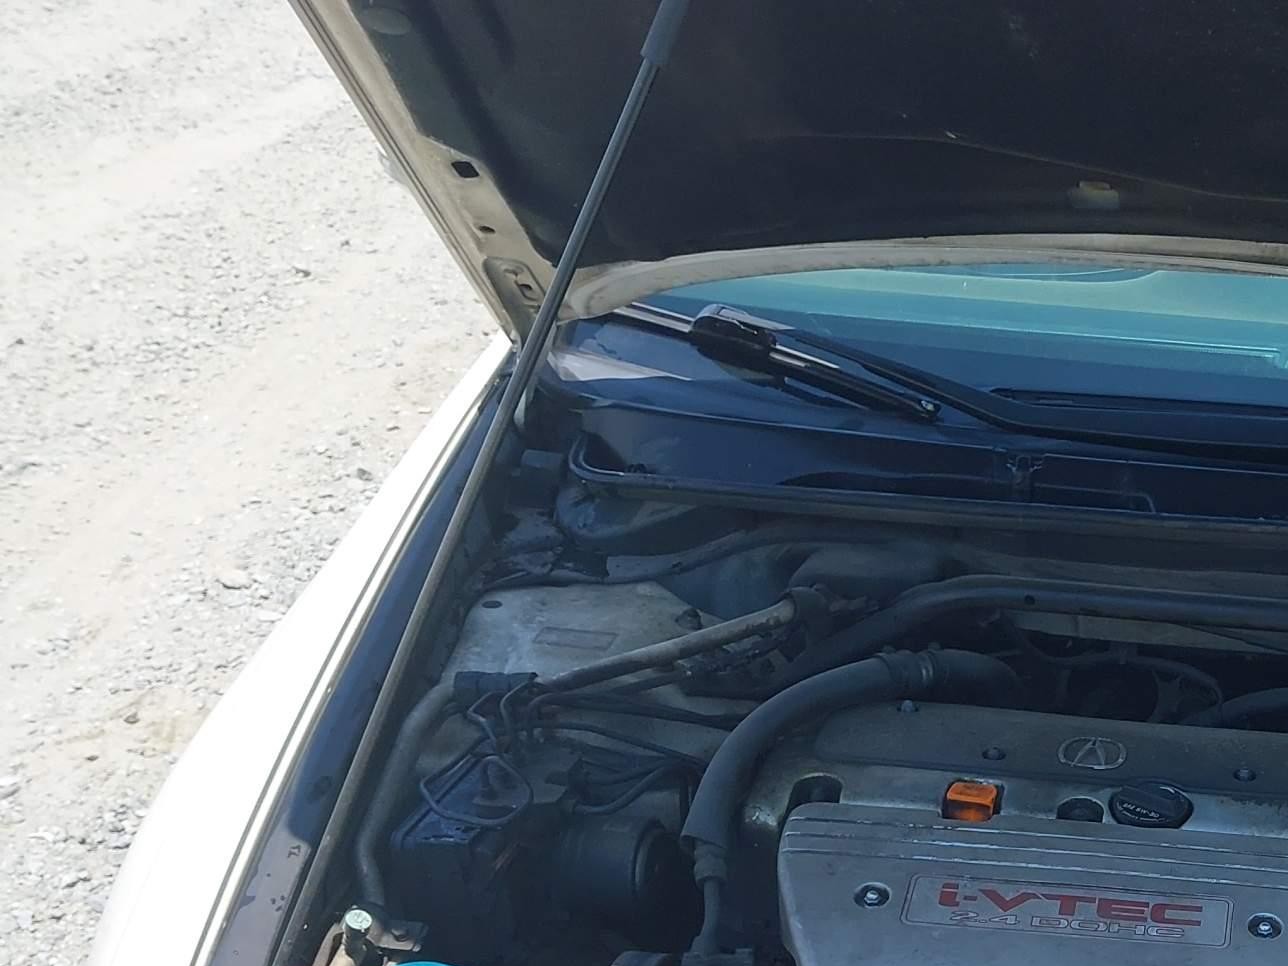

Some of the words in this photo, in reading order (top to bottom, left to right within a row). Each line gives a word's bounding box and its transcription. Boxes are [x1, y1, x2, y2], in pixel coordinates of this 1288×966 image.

[938, 882, 1203, 926] i-VTEC
[950, 910, 1020, 926] 2.4
[1030, 915, 1185, 938] DOHC
